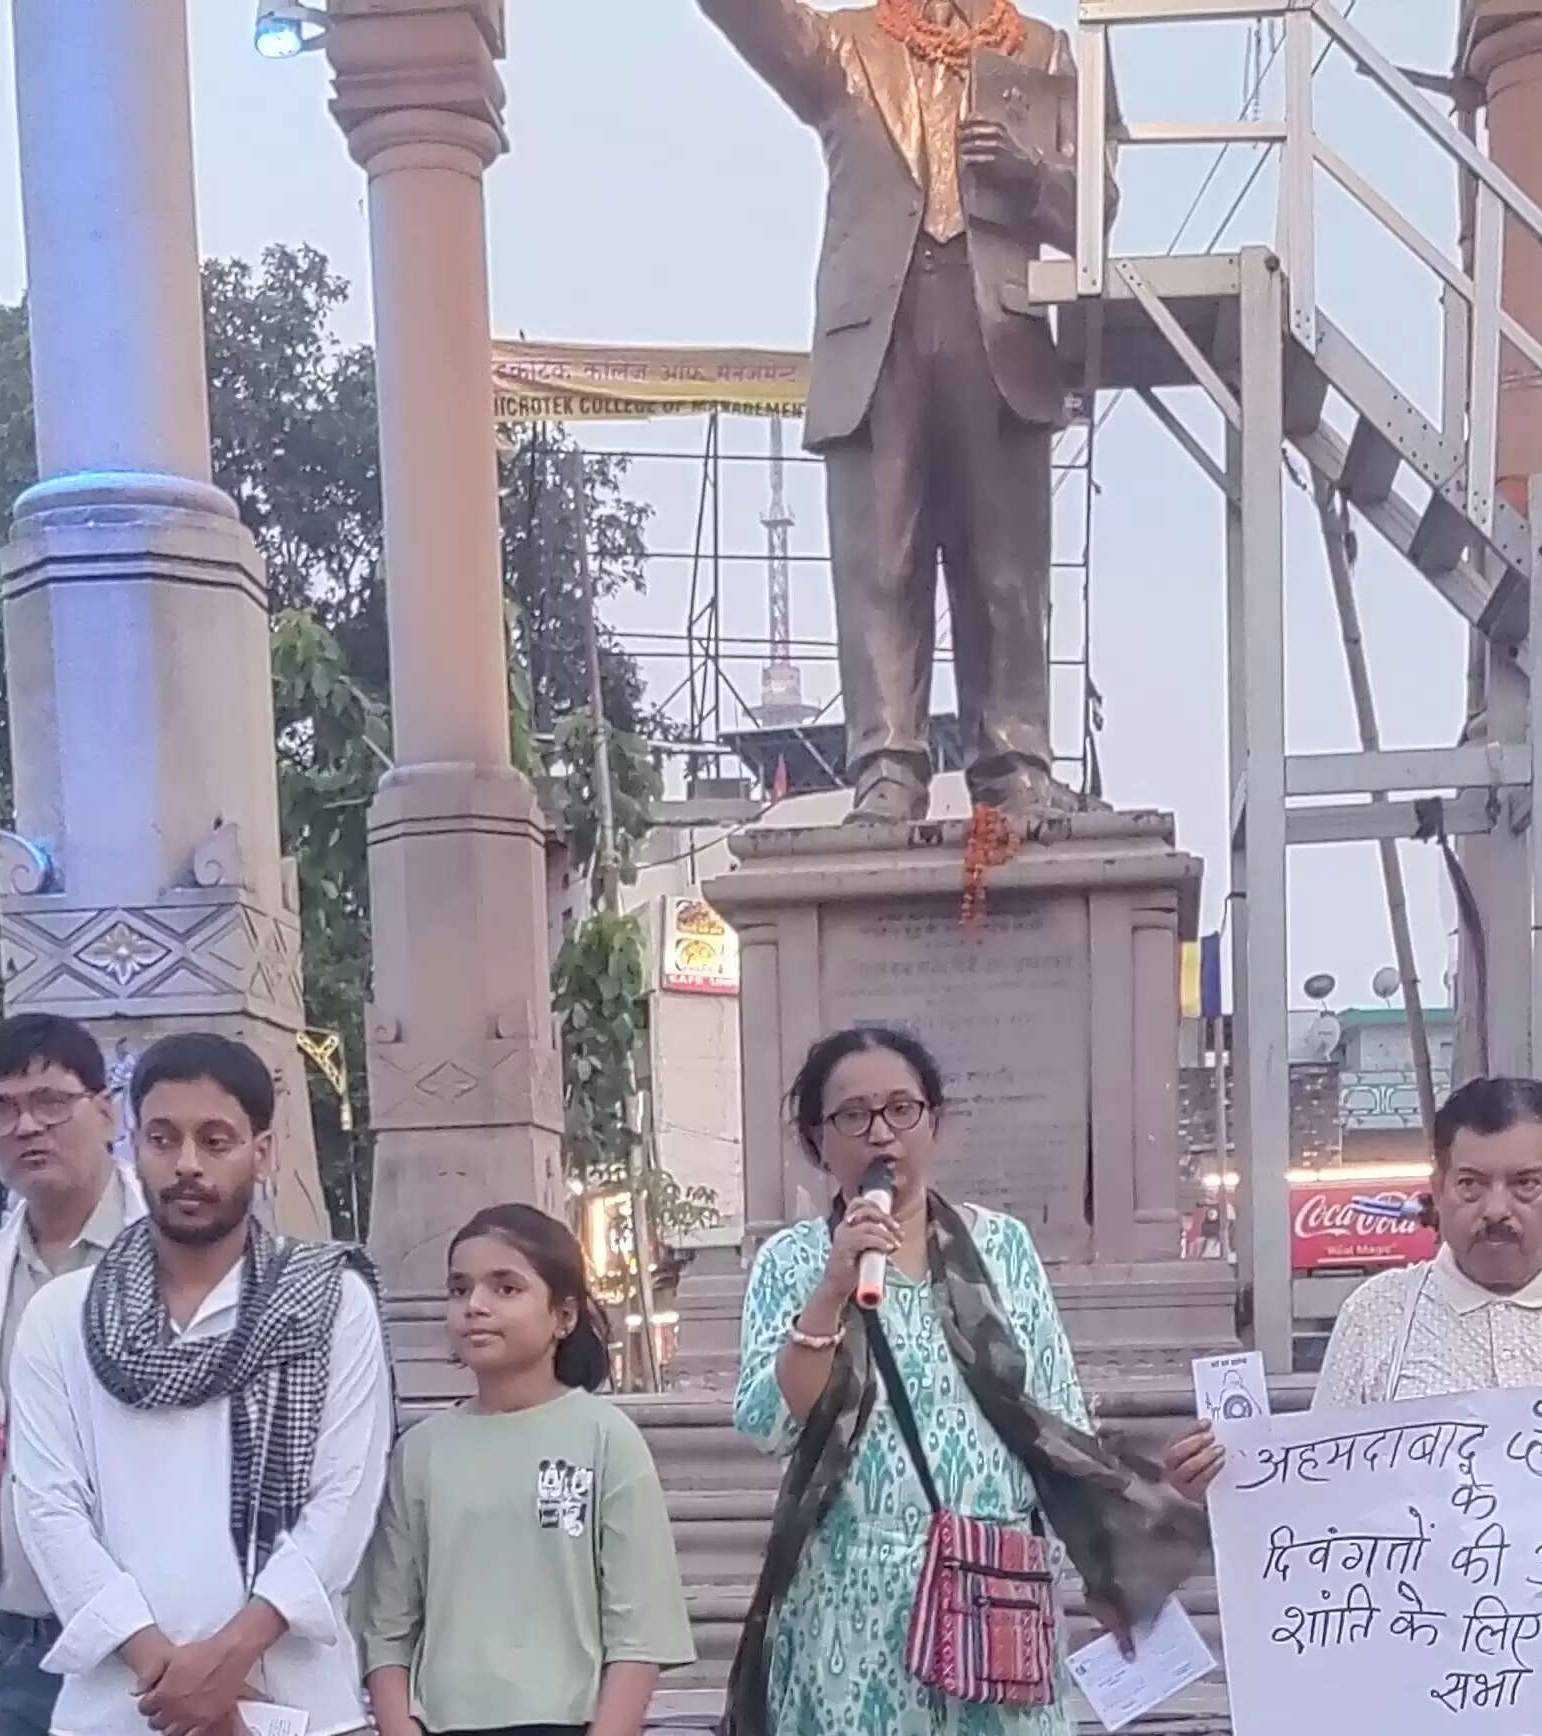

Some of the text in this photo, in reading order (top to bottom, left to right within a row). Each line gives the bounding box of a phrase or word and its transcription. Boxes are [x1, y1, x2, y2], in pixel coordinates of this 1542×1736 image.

[1235, 1421, 1489, 1490] अहमदाबाद
[1262, 1505, 1432, 1582] दिवंगतों
[1451, 1522, 1512, 1587] की
[1271, 1582, 1382, 1655] शांति
[1389, 1580, 1448, 1646] के
[1461, 1594, 1542, 1670] लिए
[1429, 1668, 1535, 1714] सभा
